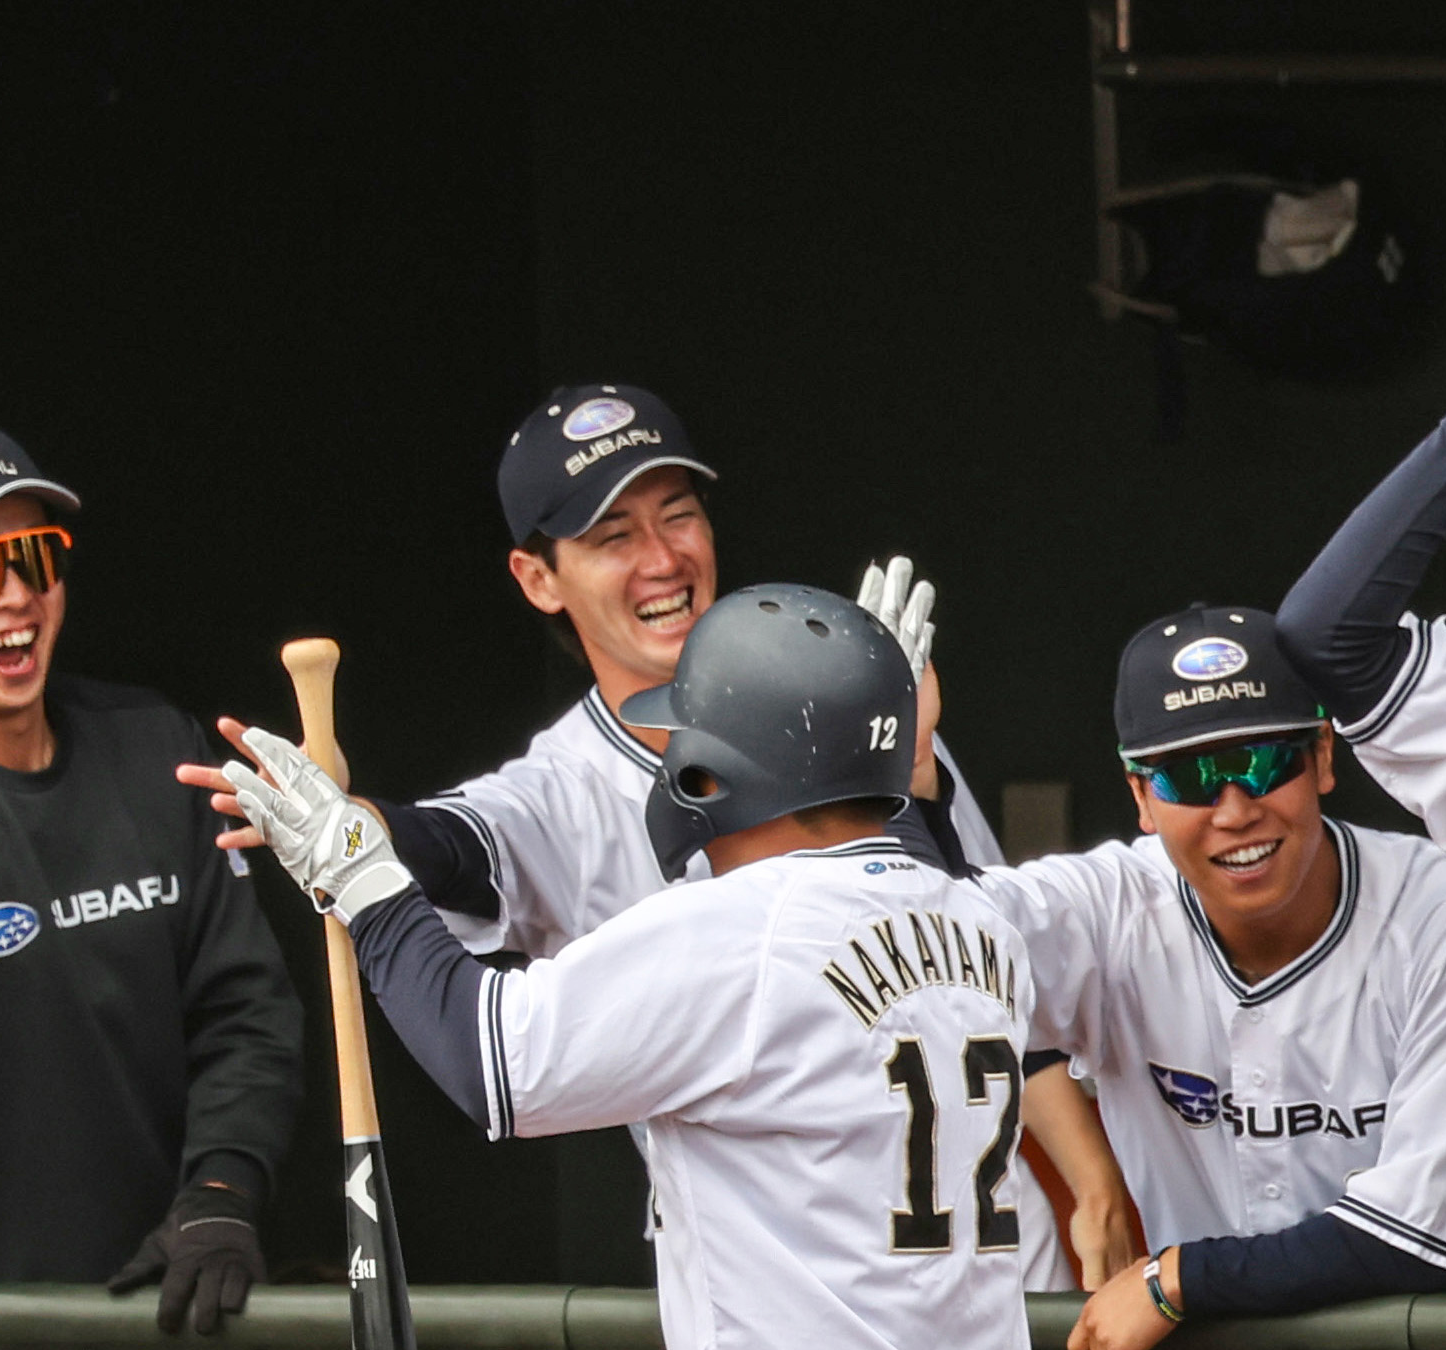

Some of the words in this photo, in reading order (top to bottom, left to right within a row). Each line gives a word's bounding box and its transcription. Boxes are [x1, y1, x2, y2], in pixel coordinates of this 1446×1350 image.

[564, 428, 662, 477] SUBARU
[1163, 680, 1267, 711] SUBARU
[869, 715, 898, 751] 12
[819, 909, 1018, 1031] NAKAYAMA
[882, 1033, 1021, 1255] 12
